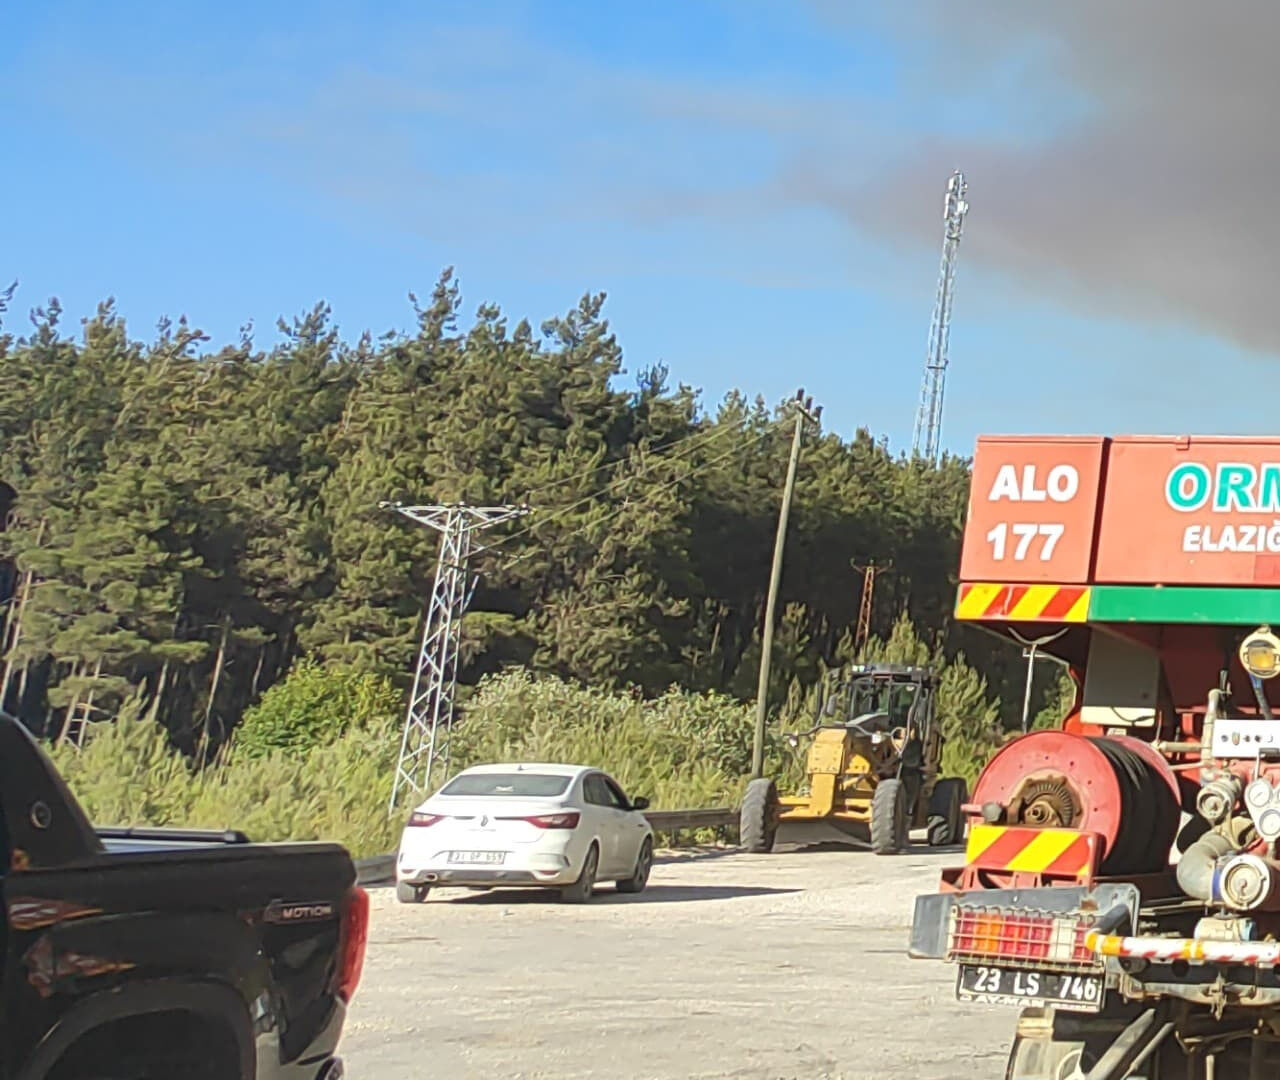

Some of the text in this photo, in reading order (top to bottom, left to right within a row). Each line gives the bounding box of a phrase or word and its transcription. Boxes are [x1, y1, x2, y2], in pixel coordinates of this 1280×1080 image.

[987, 464, 1079, 503] ALO
[986, 522, 1065, 561] 177
[974, 967, 1098, 1001] 23 LS 746
